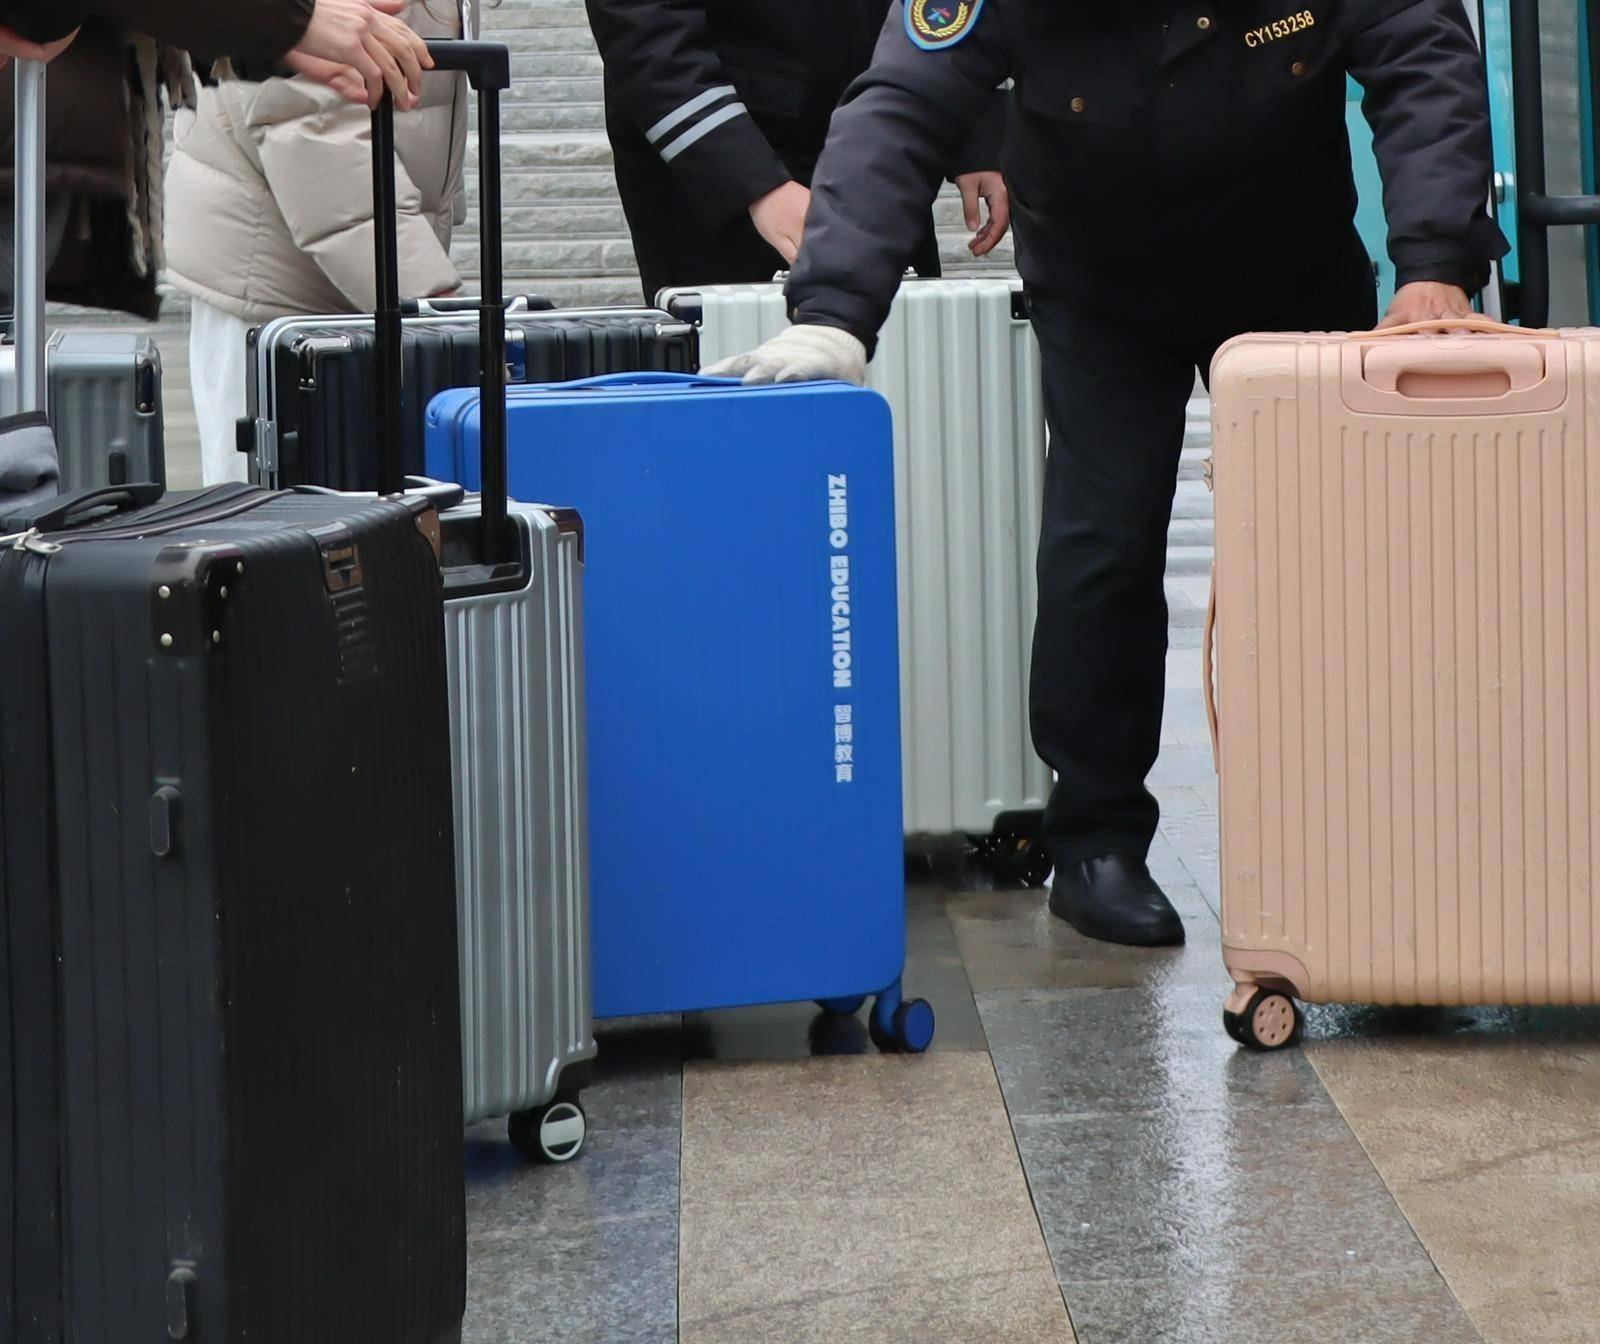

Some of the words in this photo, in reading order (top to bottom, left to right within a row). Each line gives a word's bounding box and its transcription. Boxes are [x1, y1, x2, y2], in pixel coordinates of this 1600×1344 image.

[1245, 10, 1315, 47] CY153258
[827, 473, 849, 549] ZHIBO
[830, 555, 852, 688] EDUCATION
